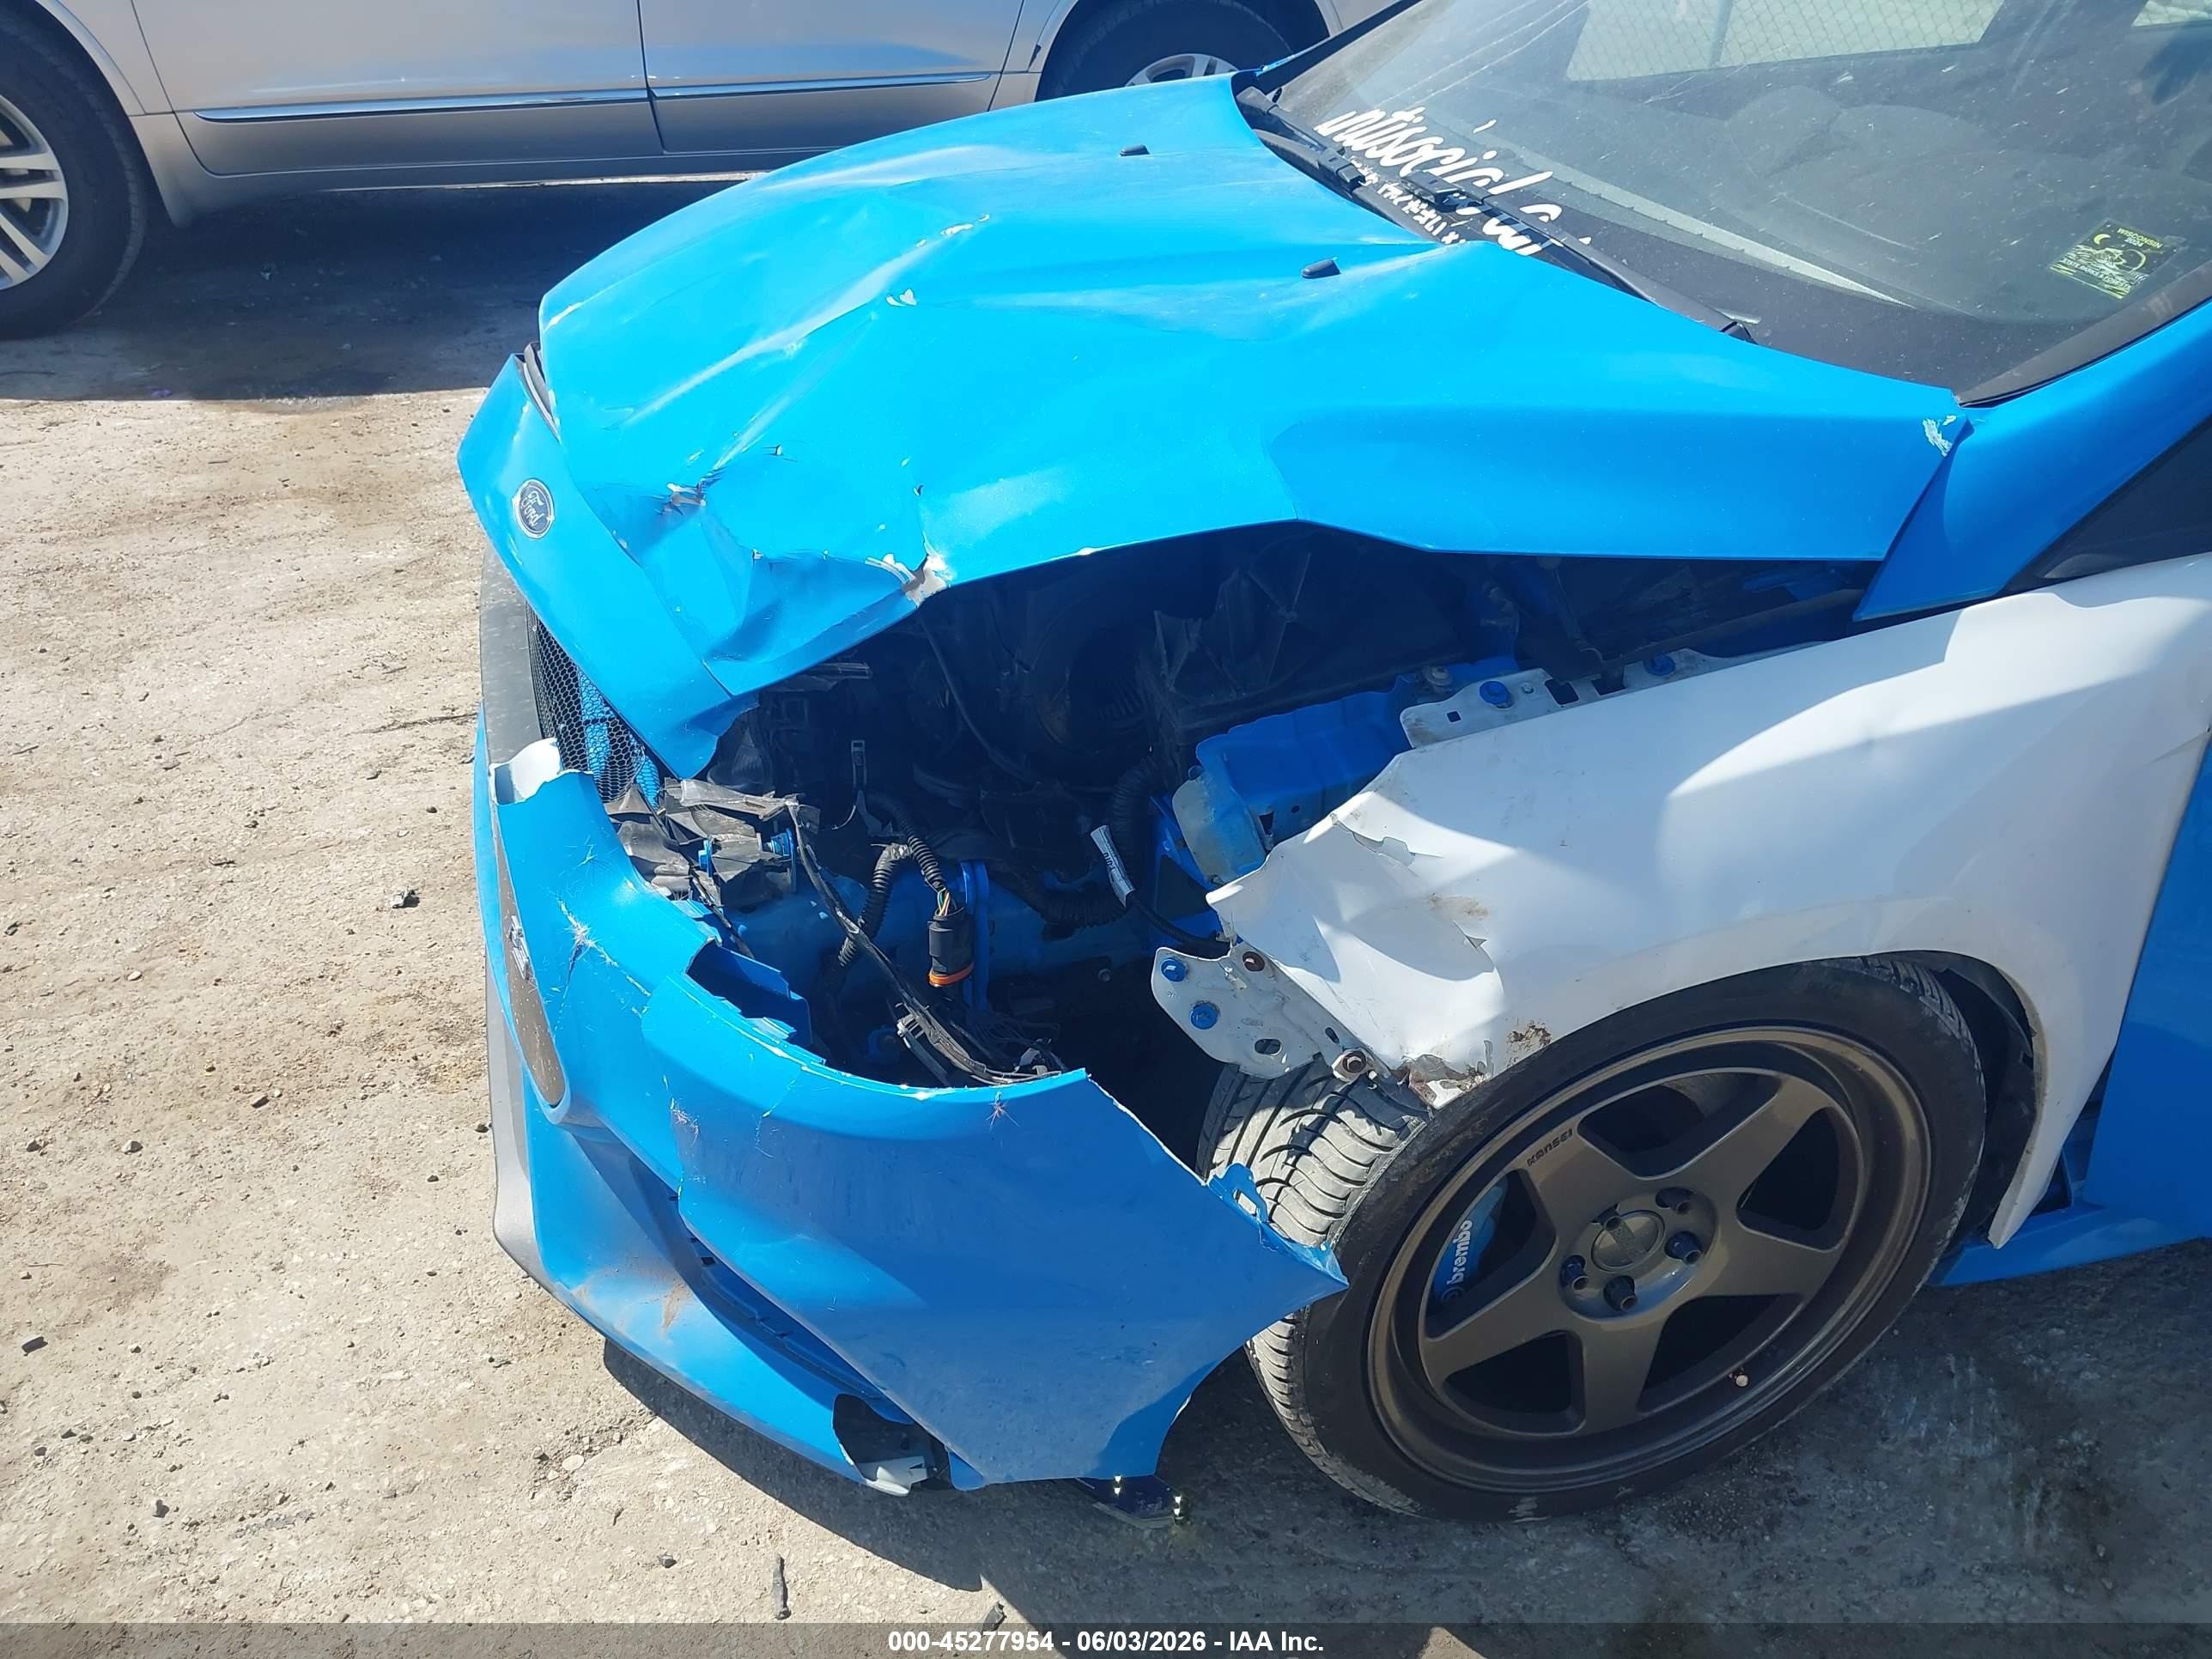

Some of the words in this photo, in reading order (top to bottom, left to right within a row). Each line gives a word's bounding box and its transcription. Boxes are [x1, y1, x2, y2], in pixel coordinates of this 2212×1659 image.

[2116, 228, 2163, 248] WISCONSIN
[520, 490, 545, 526] Ford
[1446, 1220, 1473, 1285] brembo
